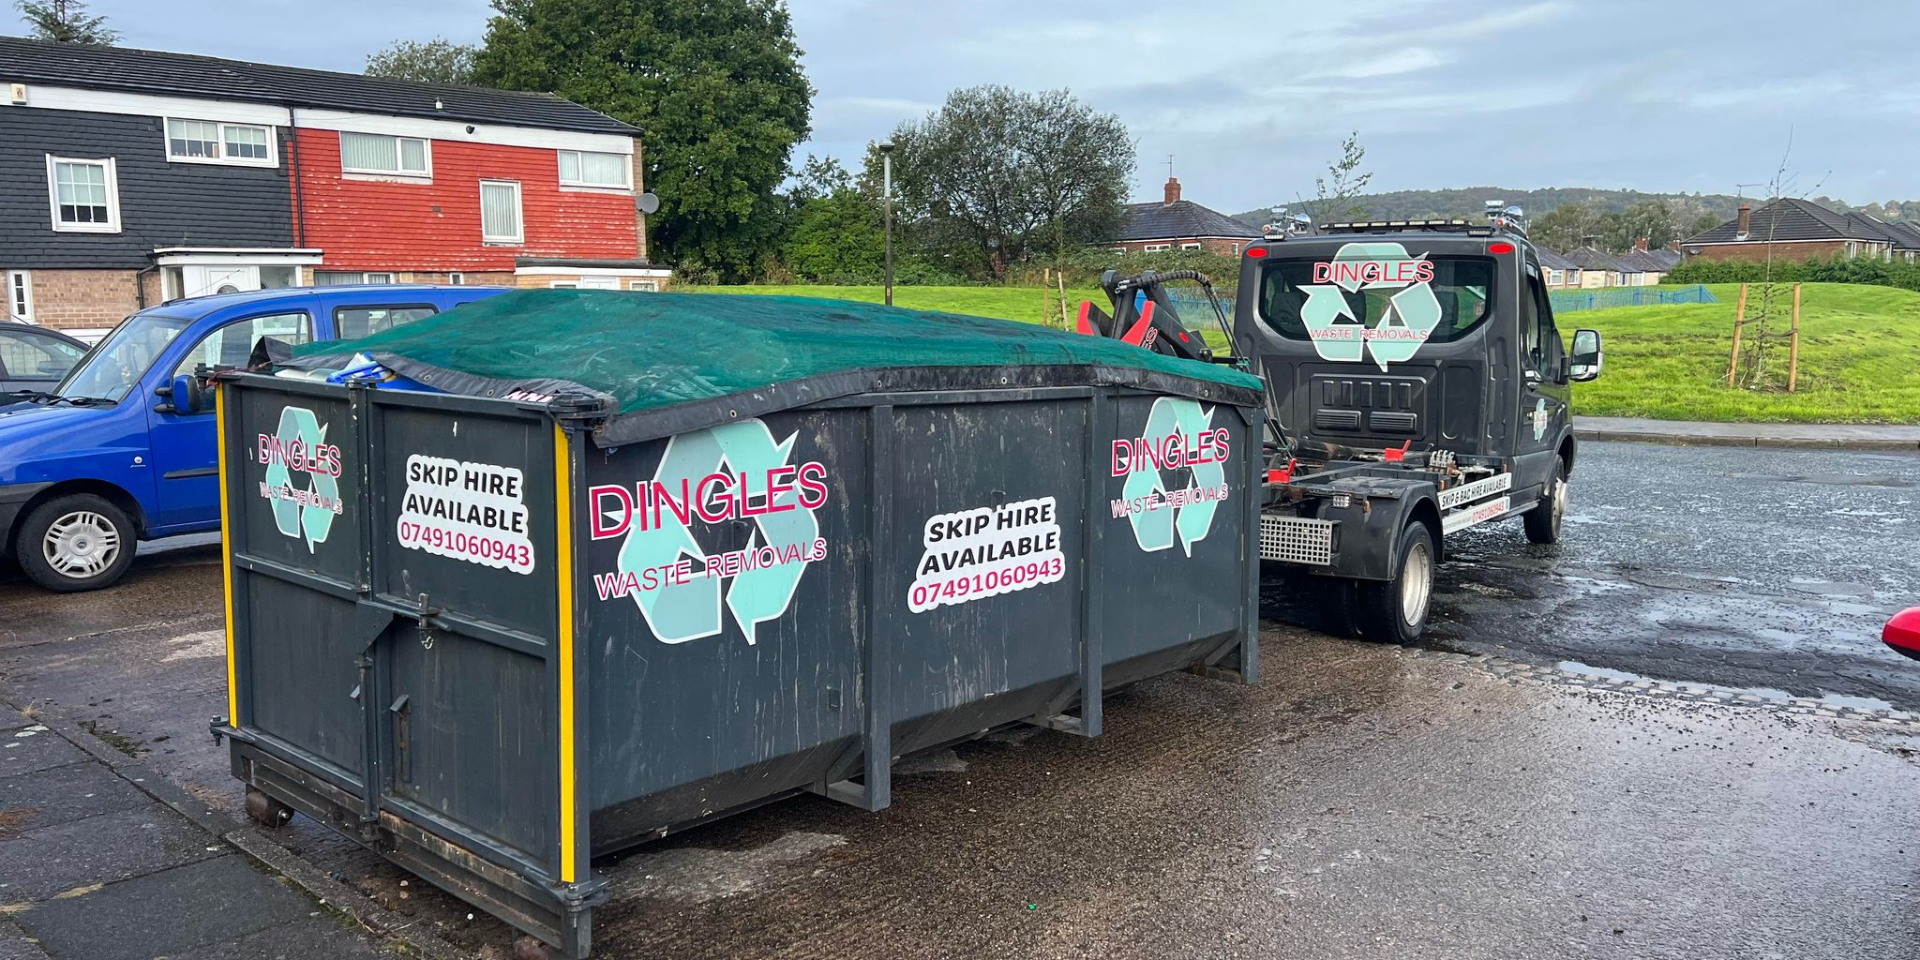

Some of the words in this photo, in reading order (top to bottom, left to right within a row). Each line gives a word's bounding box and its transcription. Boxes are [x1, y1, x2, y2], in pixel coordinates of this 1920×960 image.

[1313, 261, 1434, 283] DINGLES
[1310, 328, 1351, 339] WASTE
[1359, 328, 1429, 340] REMOVALS
[259, 433, 341, 478] DINGLES
[1112, 427, 1229, 477] DINGLES
[259, 481, 289, 501] WASTE
[292, 489, 343, 514] REMOVALS
[410, 462, 458, 487] SKIP
[464, 470, 518, 498] HIRE
[589, 461, 828, 540] DINGLES
[1111, 494, 1159, 518] WASTE
[1165, 483, 1228, 508] REMOVALS
[1442, 493, 1455, 507] SKIP
[1471, 484, 1483, 498] HIRE
[1483, 478, 1506, 494] AVAILABLE
[406, 493, 523, 534] AVAILABLE
[929, 514, 990, 542] SKIP
[997, 503, 1052, 530] HIRE
[400, 521, 530, 566] 07491060943
[921, 531, 1057, 575] AVAILABLE
[594, 561, 691, 600] WASTE
[705, 537, 827, 580] REMOVALS
[912, 558, 1061, 606] 07491060943
